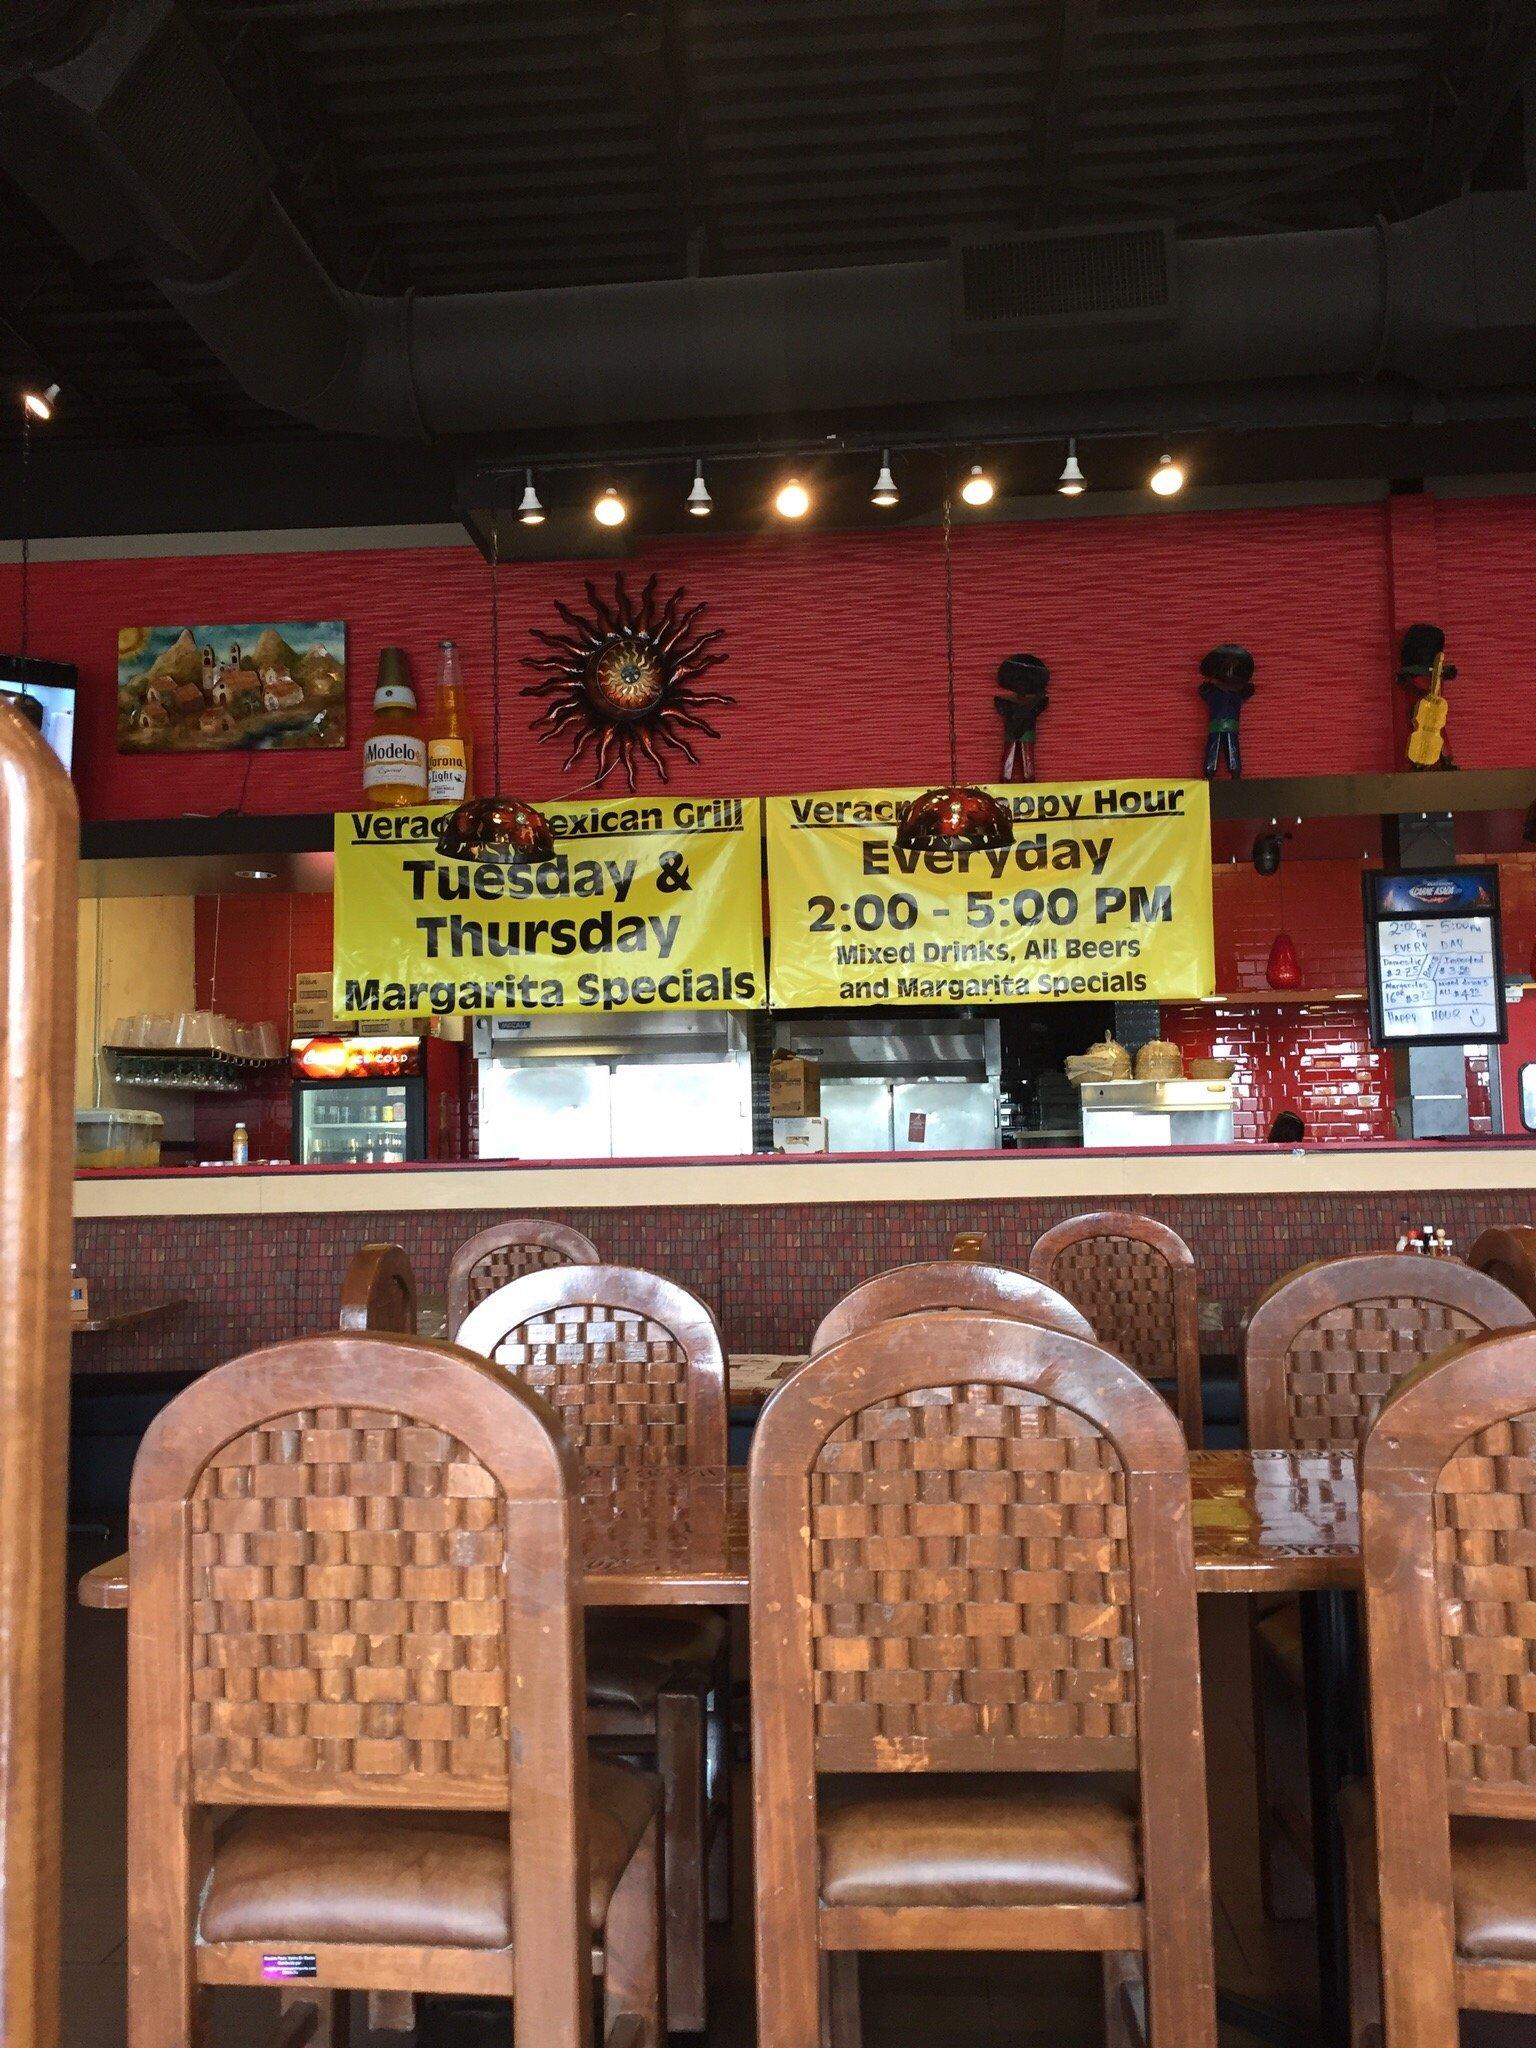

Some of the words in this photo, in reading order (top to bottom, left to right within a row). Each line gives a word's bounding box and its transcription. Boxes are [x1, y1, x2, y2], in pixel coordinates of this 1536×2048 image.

[367, 743, 415, 760] Modelo
[352, 813, 444, 839] Verac
[548, 806, 662, 836] exican
[673, 799, 743, 829] Grill
[790, 799, 910, 823] Veracr
[1095, 788, 1185, 814] Hour
[862, 833, 1114, 879] Everyday
[403, 855, 637, 902] Tuesday
[656, 851, 693, 893] &
[808, 893, 918, 932] 2:00
[966, 889, 1078, 928] 5:00
[1095, 886, 1173, 925] PM
[416, 910, 682, 958] Thursday
[836, 940, 915, 964] Mixed
[923, 939, 1016, 964] Drinks,
[1024, 938, 1057, 959] All
[1066, 937, 1141, 959] Beers
[1394, 942, 1428, 953] EVERY
[1441, 939, 1464, 950] DAY
[345, 974, 564, 1014] Margarita
[577, 967, 756, 1010] Specials
[840, 976, 889, 998] and
[897, 974, 1029, 1000] Margarita
[1037, 971, 1147, 997] Specials
